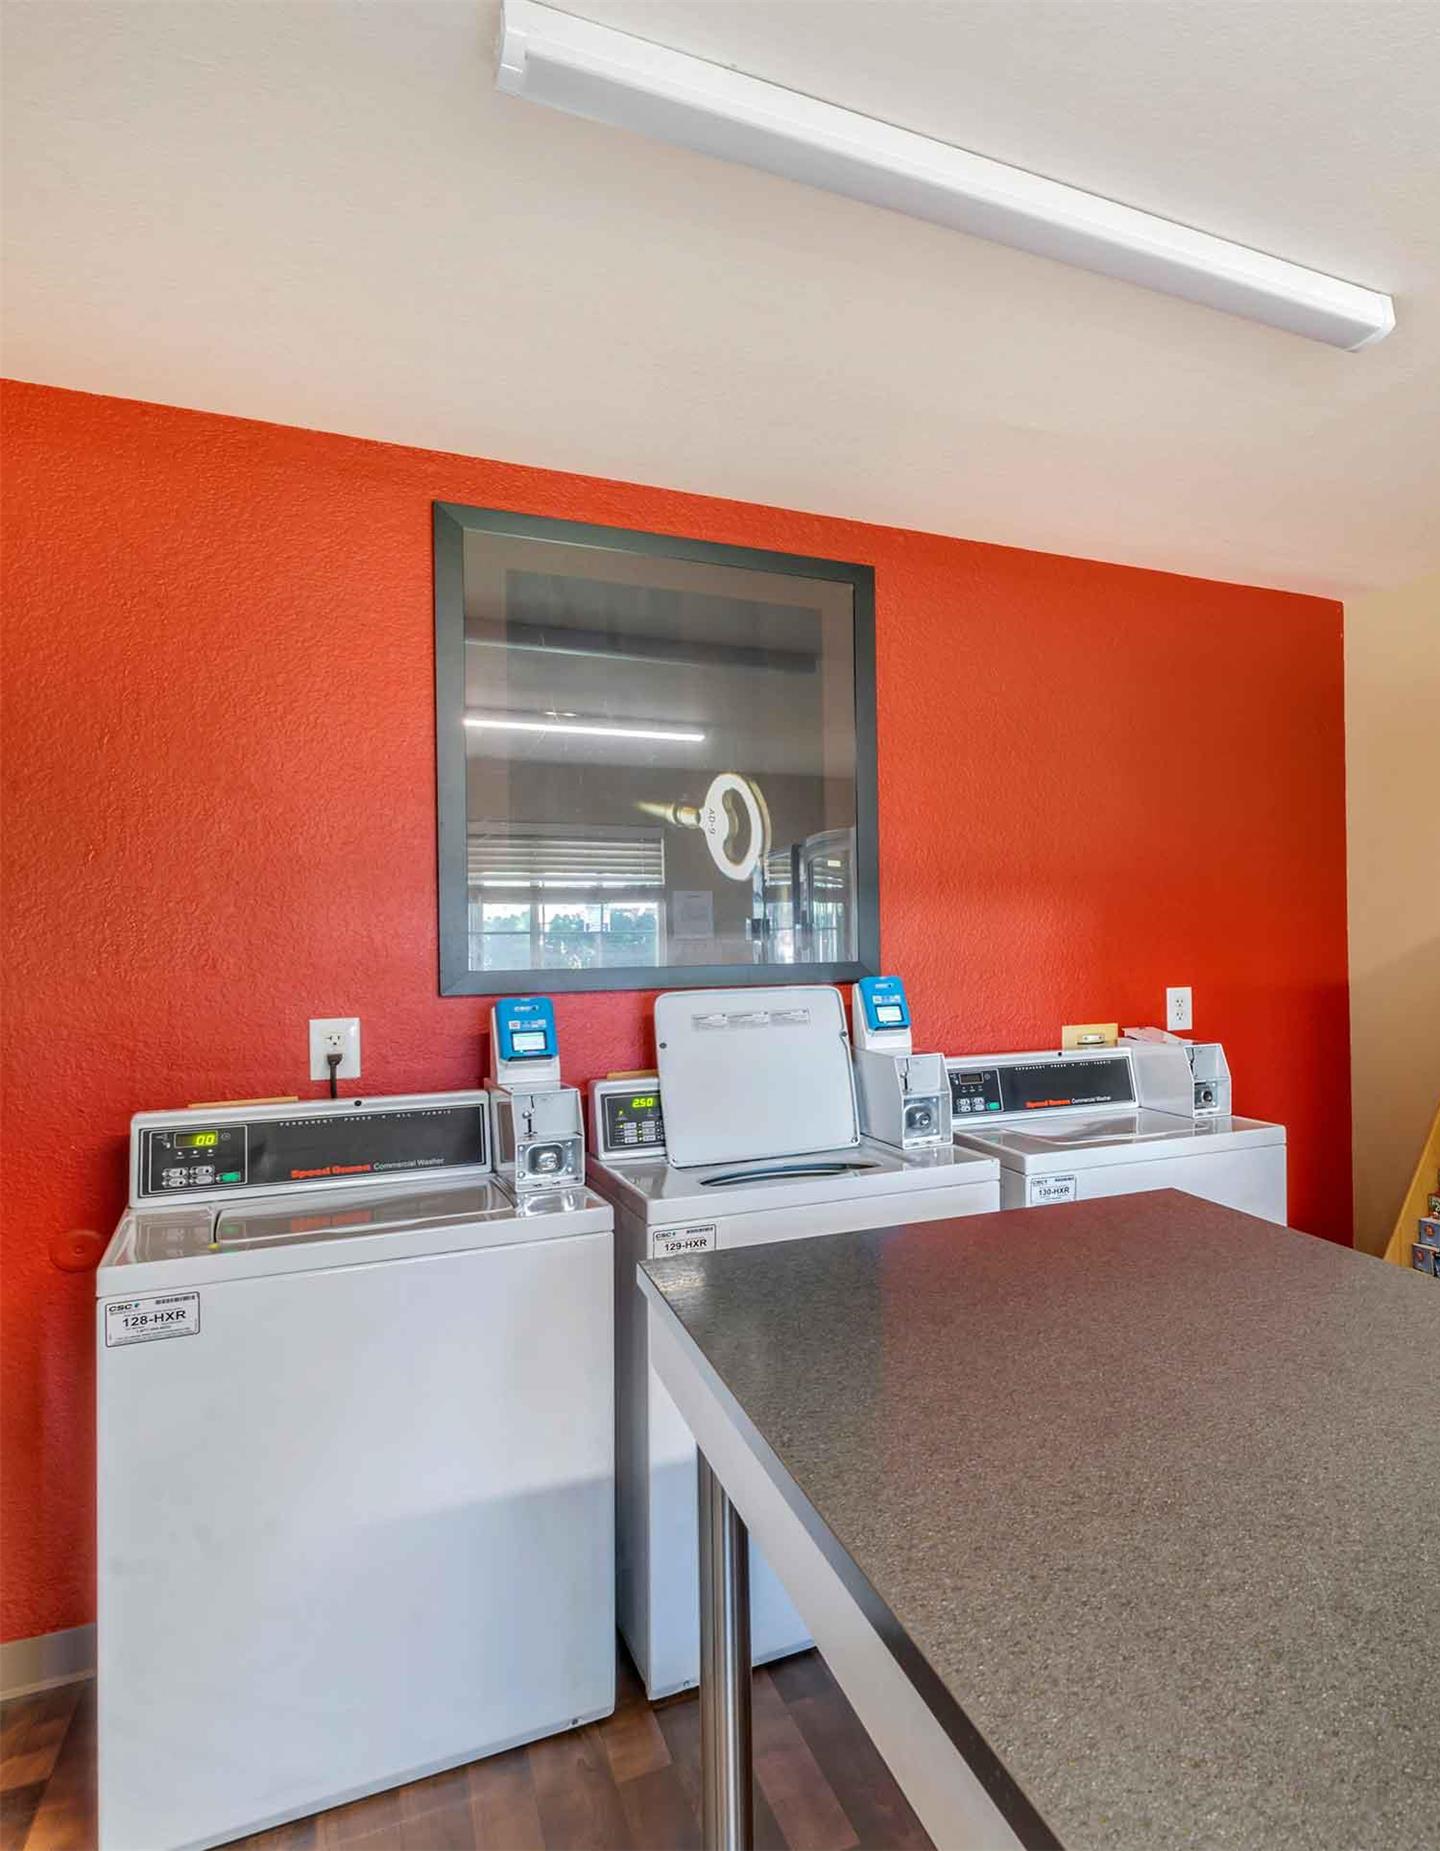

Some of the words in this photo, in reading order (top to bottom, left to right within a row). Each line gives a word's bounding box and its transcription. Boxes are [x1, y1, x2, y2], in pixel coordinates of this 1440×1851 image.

[290, 1166, 331, 1179] Speed
[332, 1163, 372, 1175] Queen
[373, 1159, 417, 1170] Commercial
[418, 1157, 446, 1168] Washer
[664, 1239, 708, 1251] 129-HXR
[108, 1303, 133, 1313] CSC
[122, 1309, 187, 1328] 128-HXR
